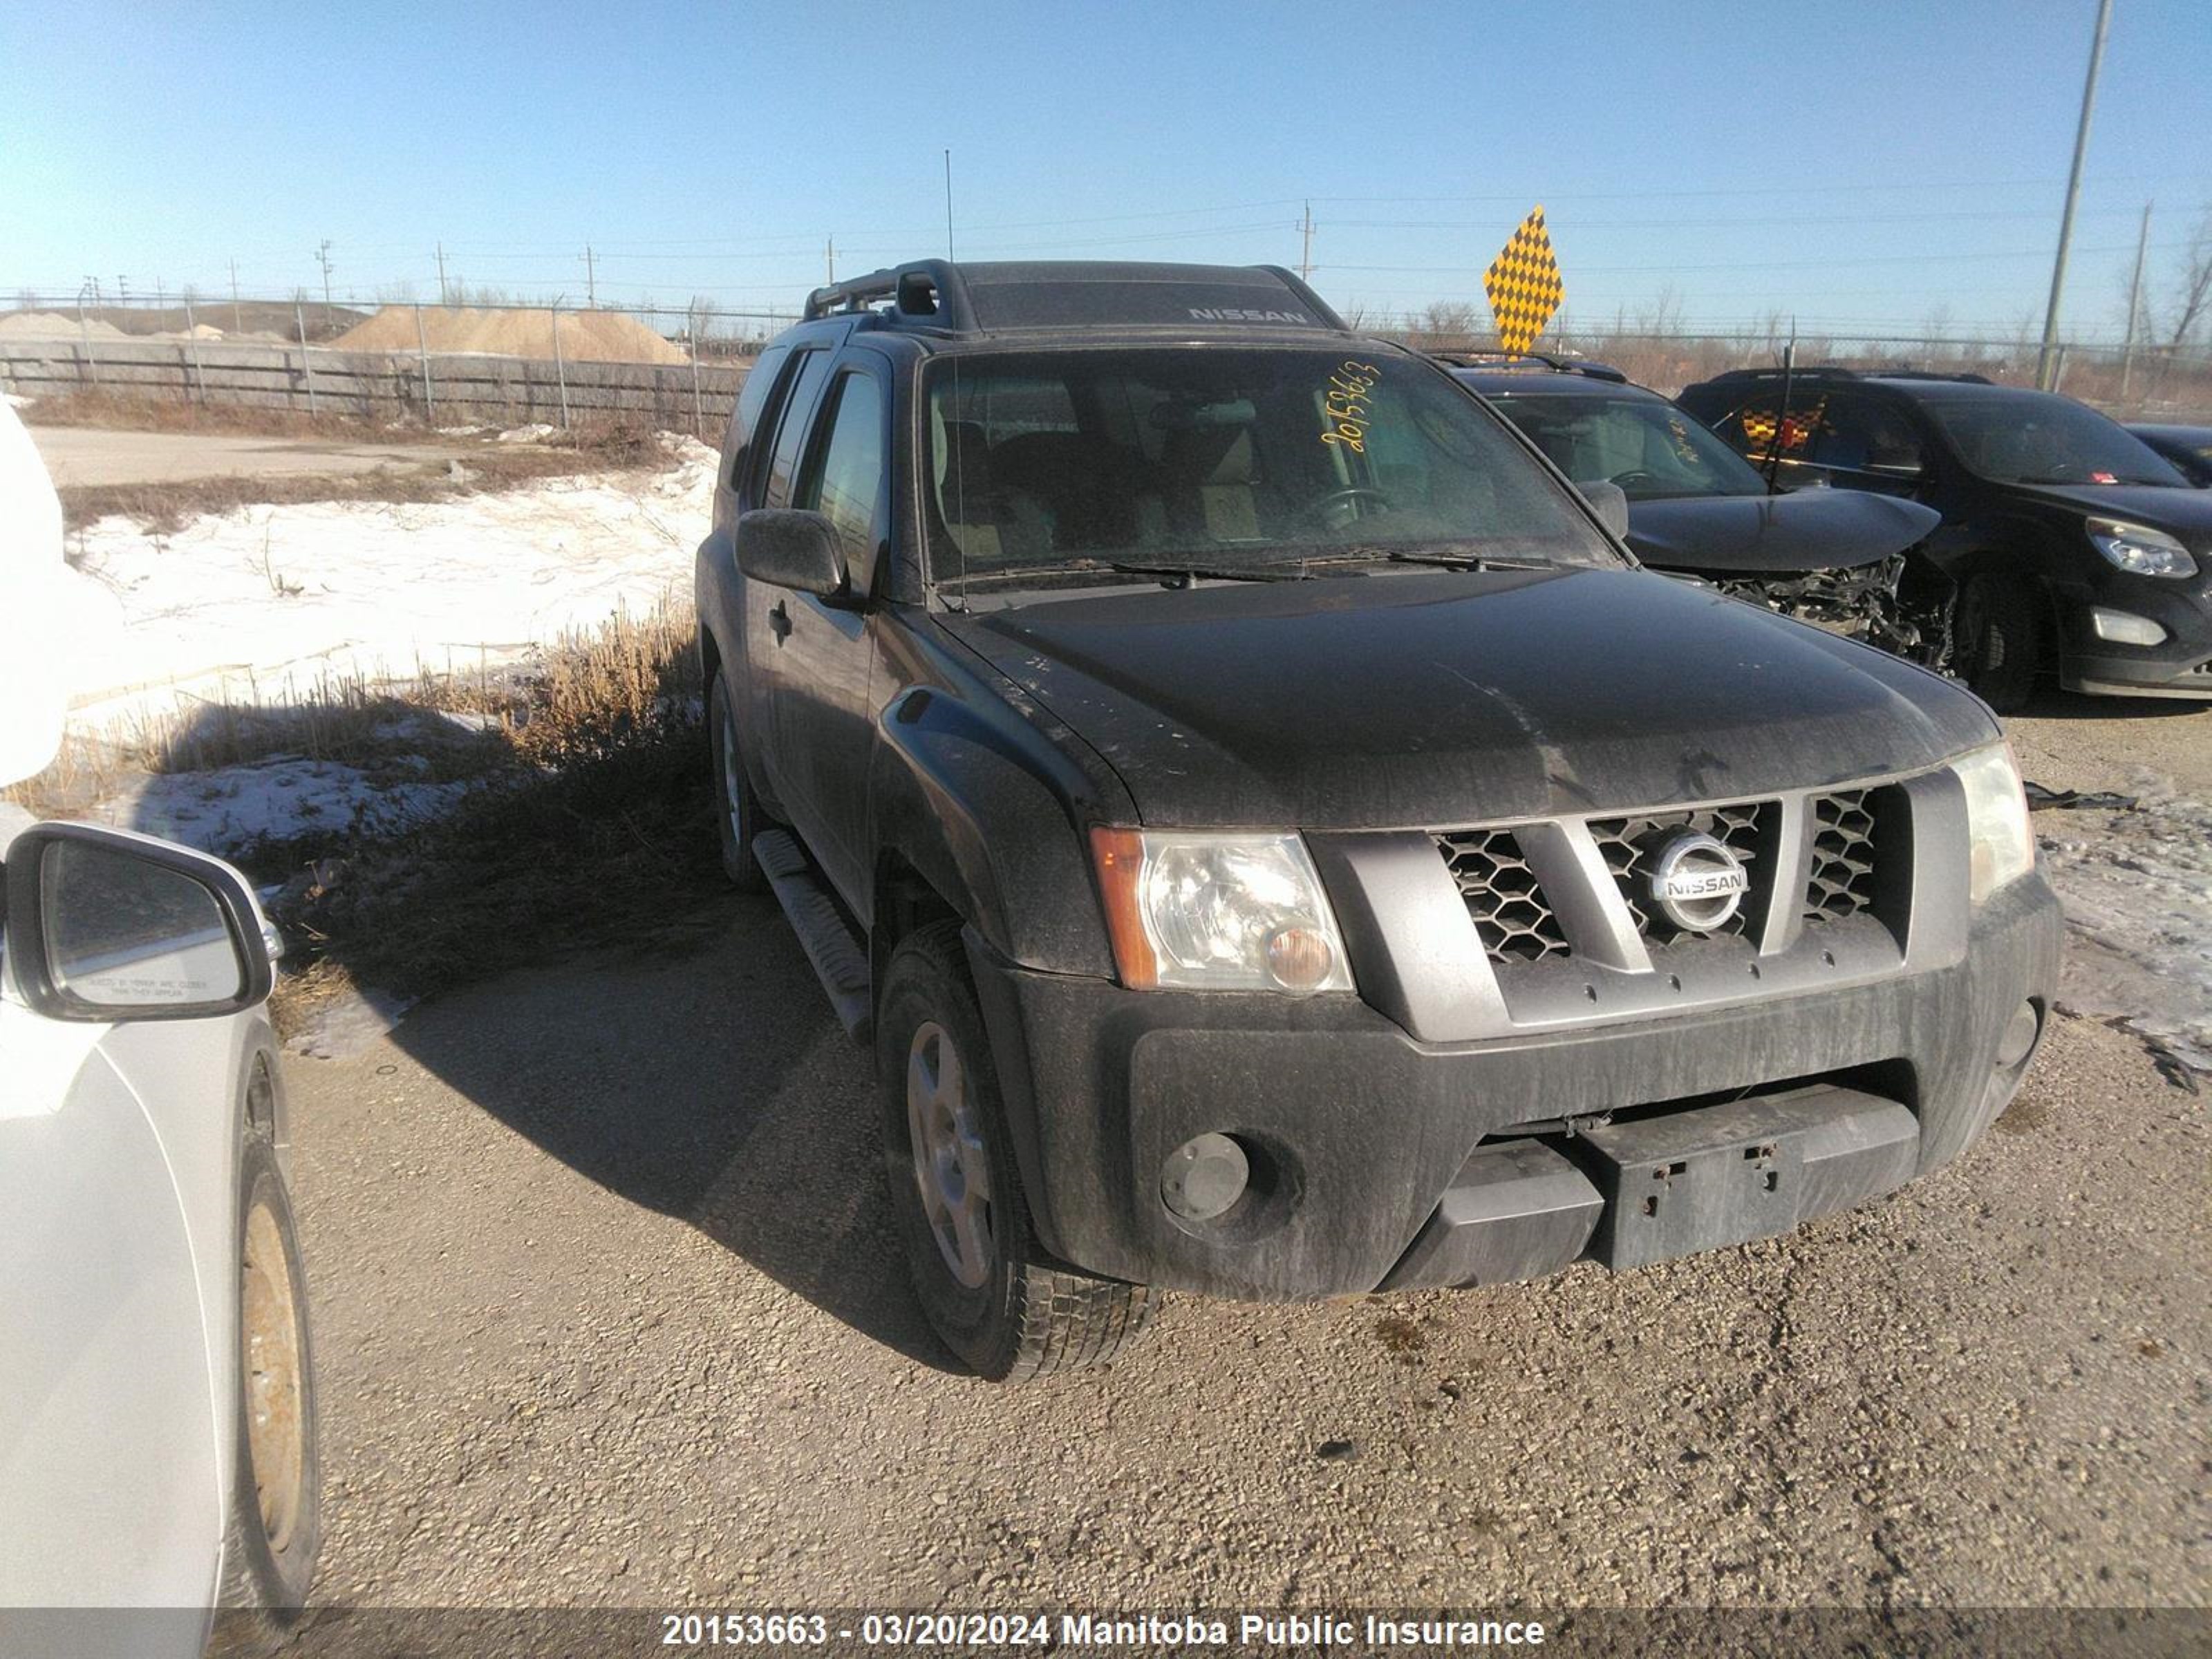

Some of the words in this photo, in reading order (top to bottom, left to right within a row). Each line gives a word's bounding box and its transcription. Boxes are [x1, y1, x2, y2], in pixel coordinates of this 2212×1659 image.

[1189, 308, 1307, 324] NISSAN
[1321, 361, 1382, 453] 20153663
[1667, 873, 1742, 897] NISSAN
